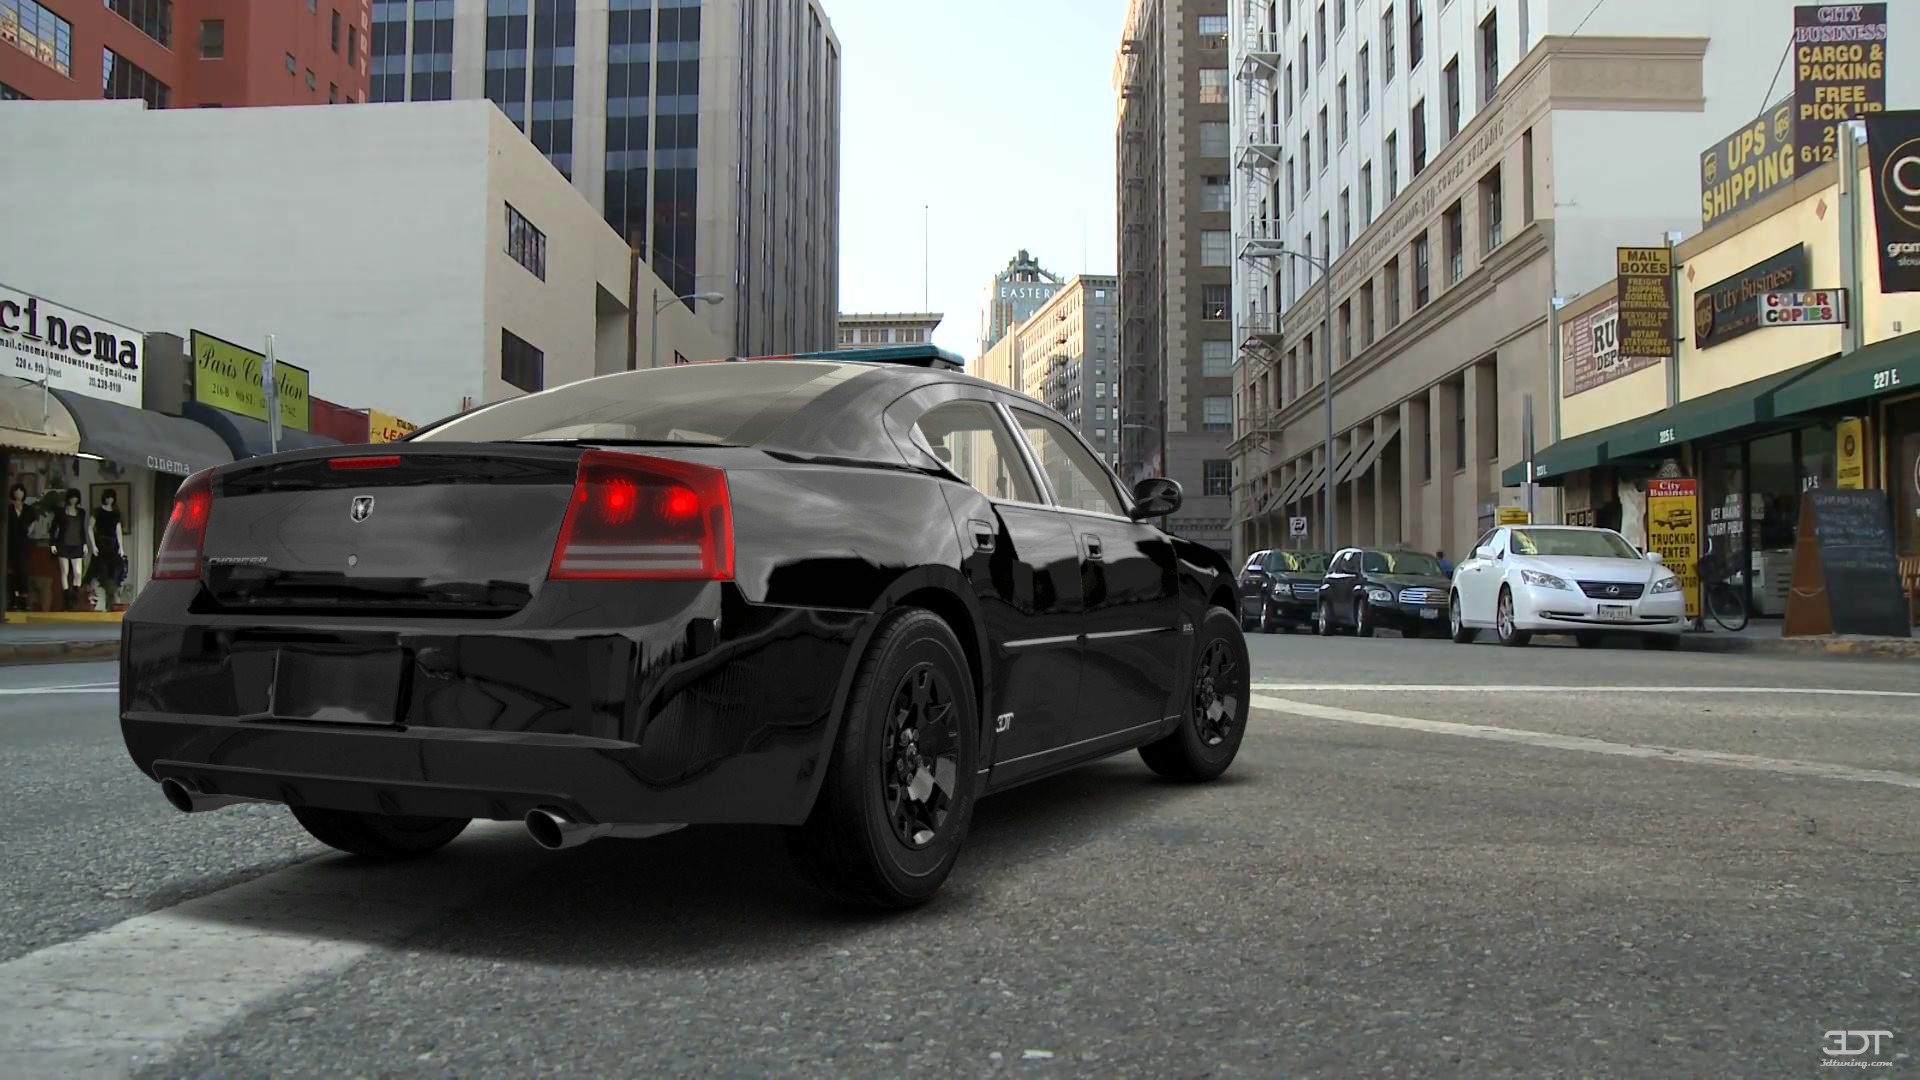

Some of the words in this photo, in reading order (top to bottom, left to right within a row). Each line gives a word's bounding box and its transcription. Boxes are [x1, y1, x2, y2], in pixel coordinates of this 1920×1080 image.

[1818, 6, 1863, 22] CITY
[1796, 24, 1887, 42] BUSINESS
[1798, 44, 1863, 63] CARGO
[1869, 43, 1883, 61] &
[1799, 63, 1882, 81] PACKING
[1815, 86, 1866, 103] FREE
[1800, 103, 1848, 120] PICK
[1728, 121, 1766, 171] UPS
[1702, 143, 1795, 223] SHIPPING
[1627, 250, 1661, 262] MAIL
[1621, 262, 1668, 274] BOXES
[1713, 288, 1738, 312] City
[1741, 264, 1793, 301] Business
[1766, 292, 1829, 307] COLOR
[1766, 307, 1833, 322] COPIES
[0, 297, 138, 370] cinema
[1593, 319, 1618, 354] RU
[199, 344, 236, 379] Paris
[1873, 370, 1890, 390] 227
[147, 455, 190, 475] cinema
[1650, 488, 1695, 497] Business
[1659, 481, 1681, 491] City
[1651, 533, 1696, 546] TRUCKING
[1656, 546, 1691, 559] CENTER
